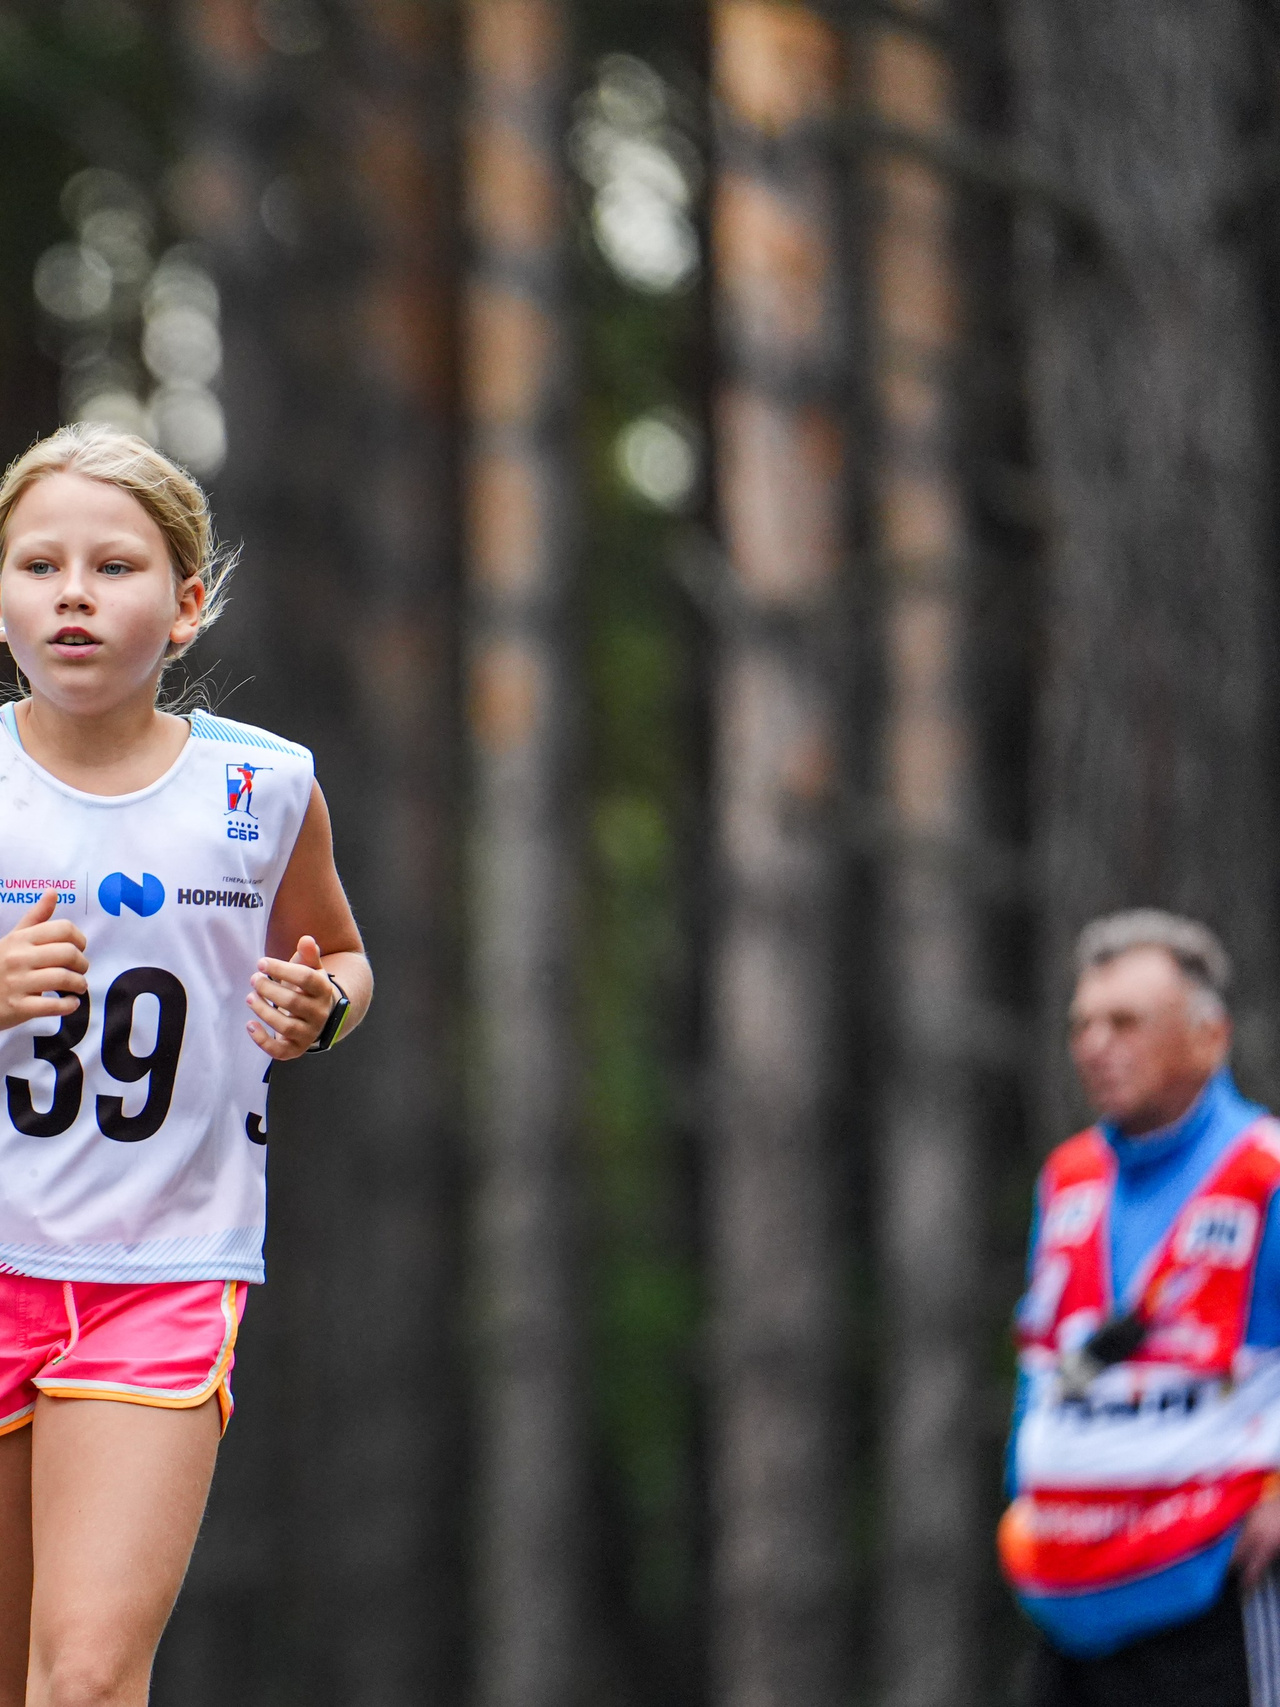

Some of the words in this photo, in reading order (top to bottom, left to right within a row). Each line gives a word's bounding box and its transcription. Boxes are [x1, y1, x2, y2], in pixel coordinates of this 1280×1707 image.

[227, 827, 259, 842] СБР
[5, 879, 76, 890] UNIVERSIADE
[56, 892, 76, 904] 019
[5, 966, 187, 1142] 39
